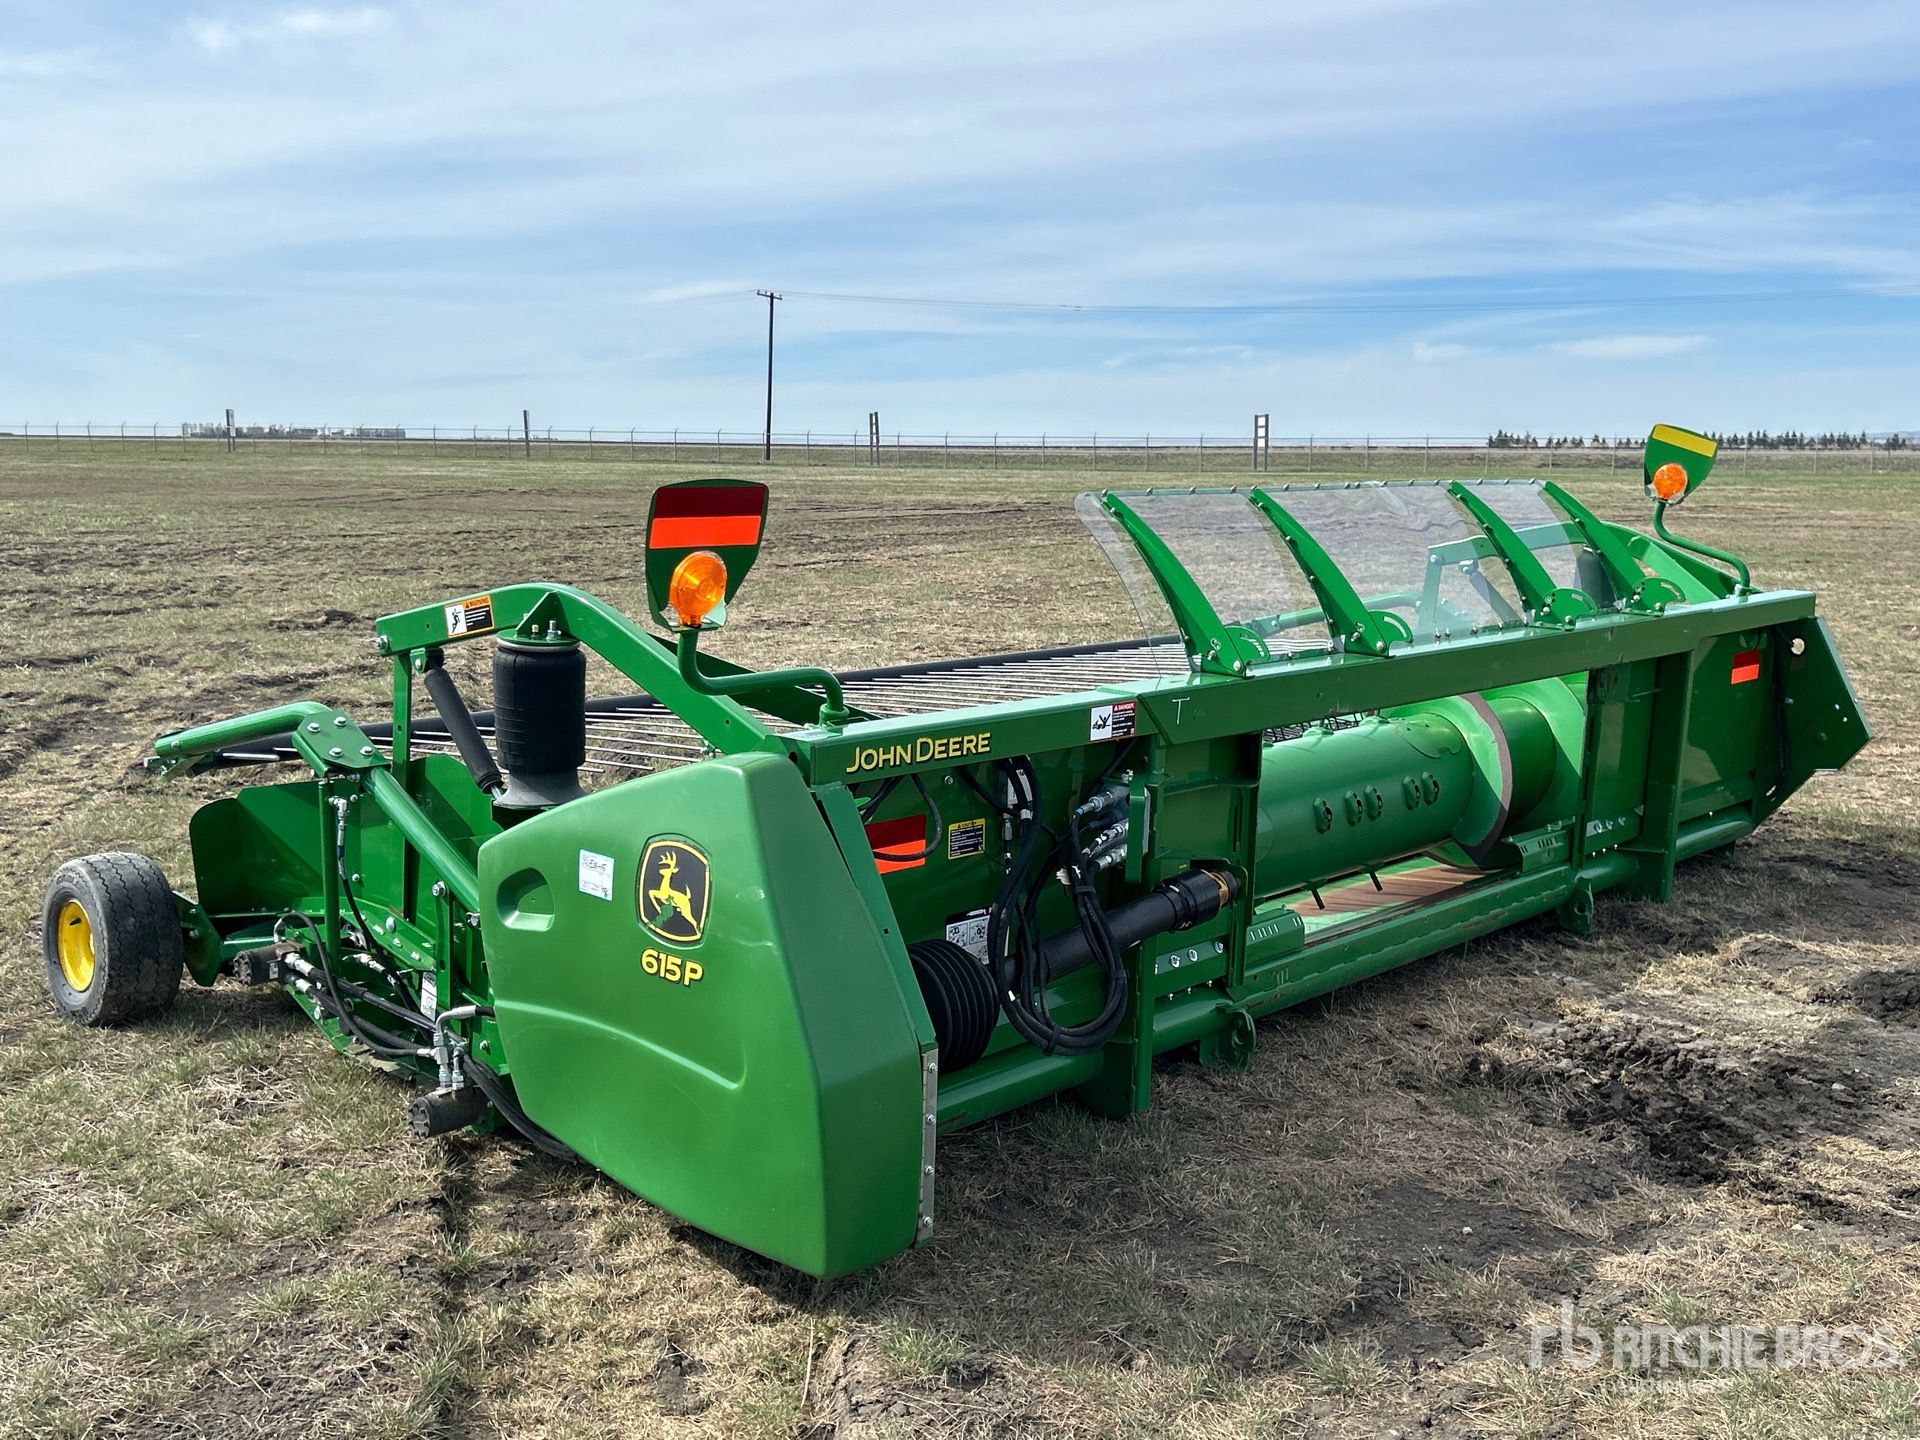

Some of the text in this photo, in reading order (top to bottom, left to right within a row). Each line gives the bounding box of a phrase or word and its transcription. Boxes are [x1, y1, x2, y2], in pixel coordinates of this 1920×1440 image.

[846, 732, 992, 774] JOHN DEERE
[641, 948, 704, 987] 615P
